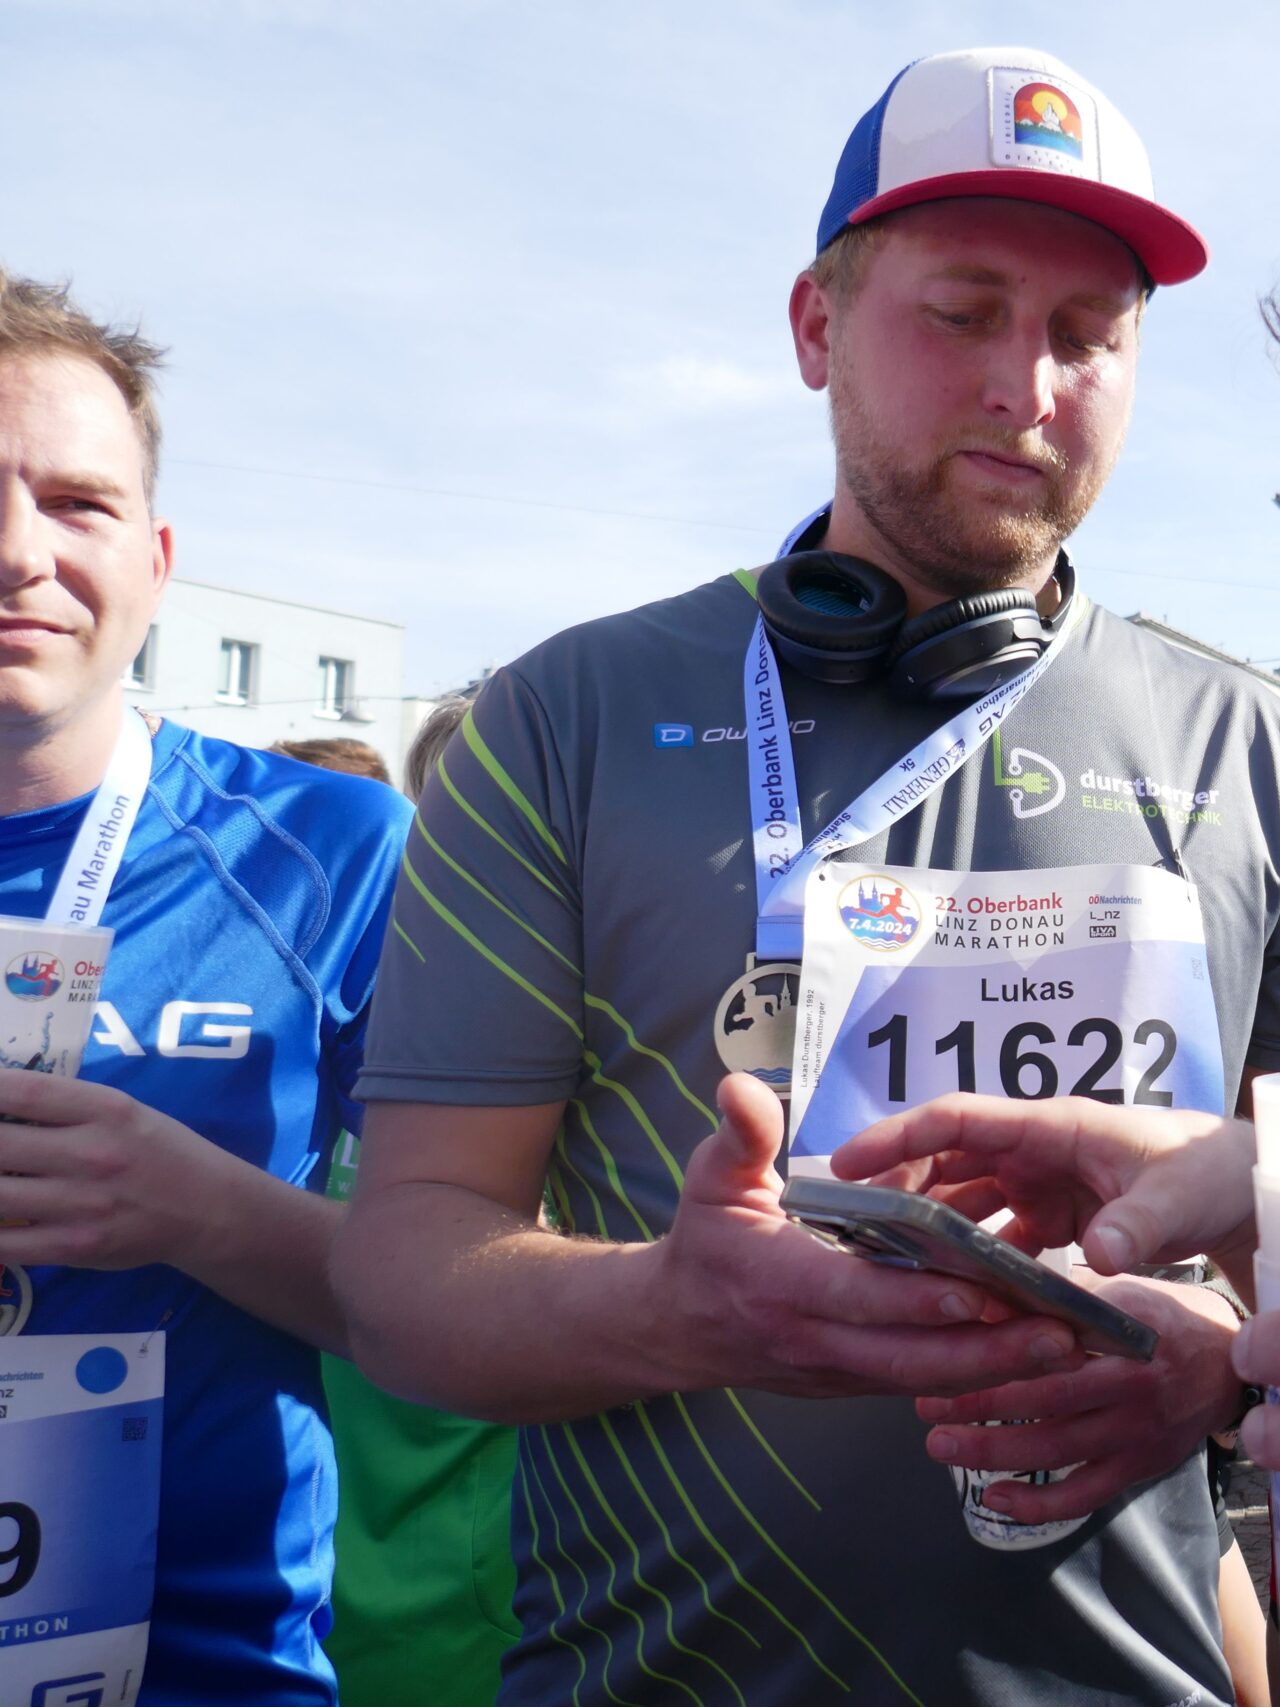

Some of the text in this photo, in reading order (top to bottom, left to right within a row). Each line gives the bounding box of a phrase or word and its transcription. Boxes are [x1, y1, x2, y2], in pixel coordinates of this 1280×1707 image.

[756, 688, 776, 732] Linz
[978, 703, 1006, 737] AG
[899, 758, 916, 772] 5k
[758, 734, 789, 840] Oberbank
[881, 756, 951, 815] GENERALI
[1080, 769, 1220, 811] durstberger
[1082, 795, 1222, 826] ELEKTROTECHNIK
[77, 795, 131, 890] Marathon
[935, 892, 1063, 915] 22. Oberbank
[849, 917, 912, 938] 7.4.2024
[935, 913, 1064, 932] LINZ DONAU
[1090, 926, 1115, 934] LIVA
[935, 931, 1065, 950] MARATHON
[71, 979, 94, 989] LINZ
[981, 977, 1075, 1003] Lukas
[800, 1063, 809, 1088] Lukas
[806, 989, 814, 1009] 1992
[812, 1001, 825, 1089] Laufteam durstberger
[867, 1013, 1178, 1107] 11622
